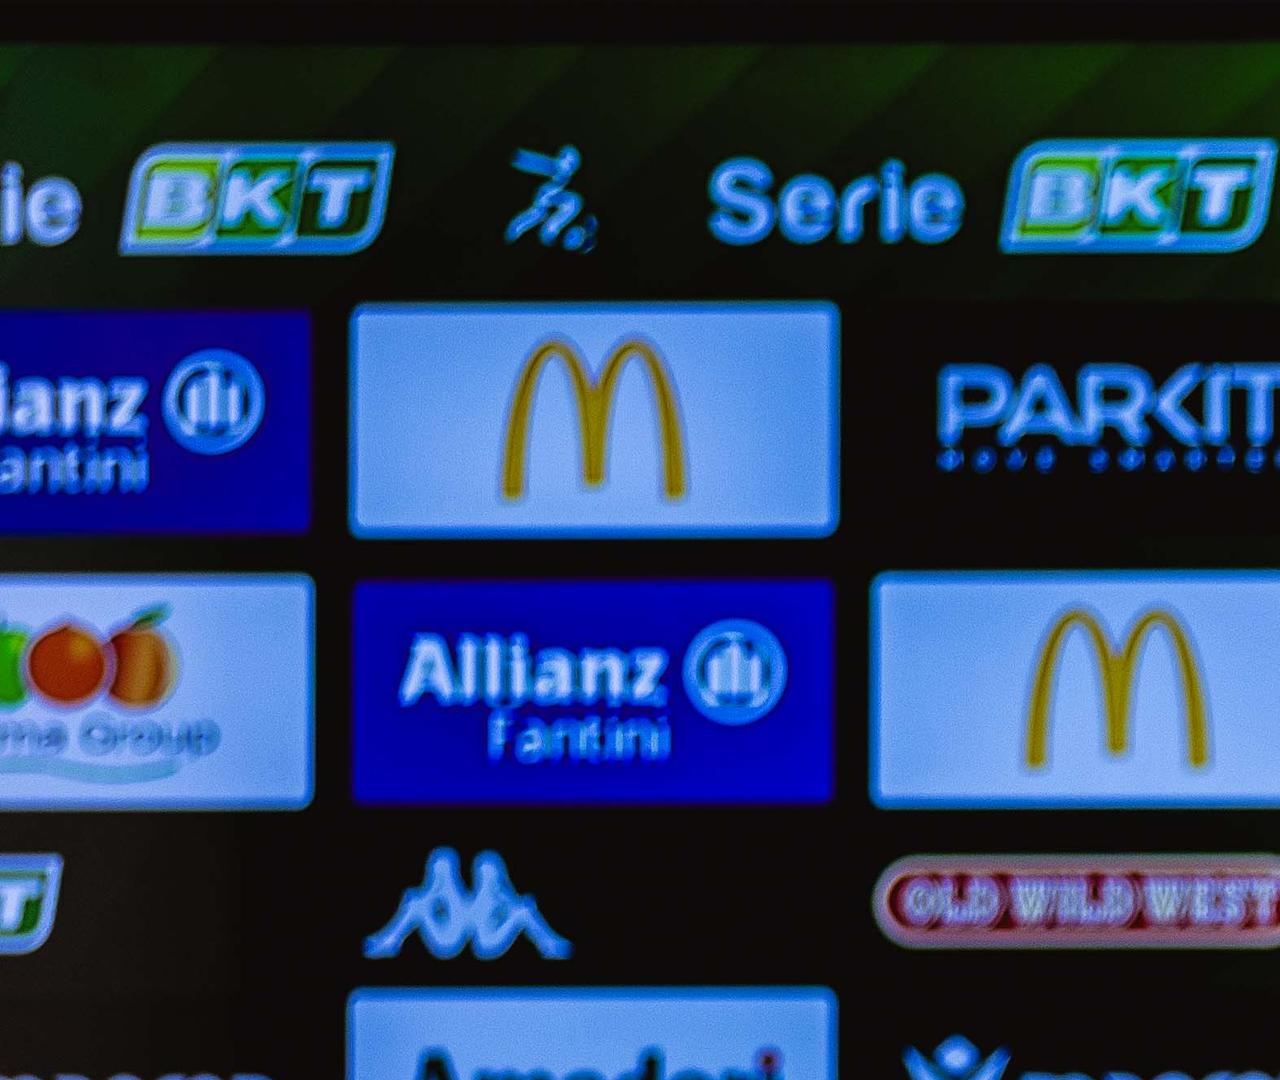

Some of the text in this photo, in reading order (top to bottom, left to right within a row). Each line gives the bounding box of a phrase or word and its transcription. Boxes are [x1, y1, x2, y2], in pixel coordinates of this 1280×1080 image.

[142, 166, 372, 236] BKT
[710, 158, 1252, 244] Serie BKT
[401, 635, 666, 705] Allianz
